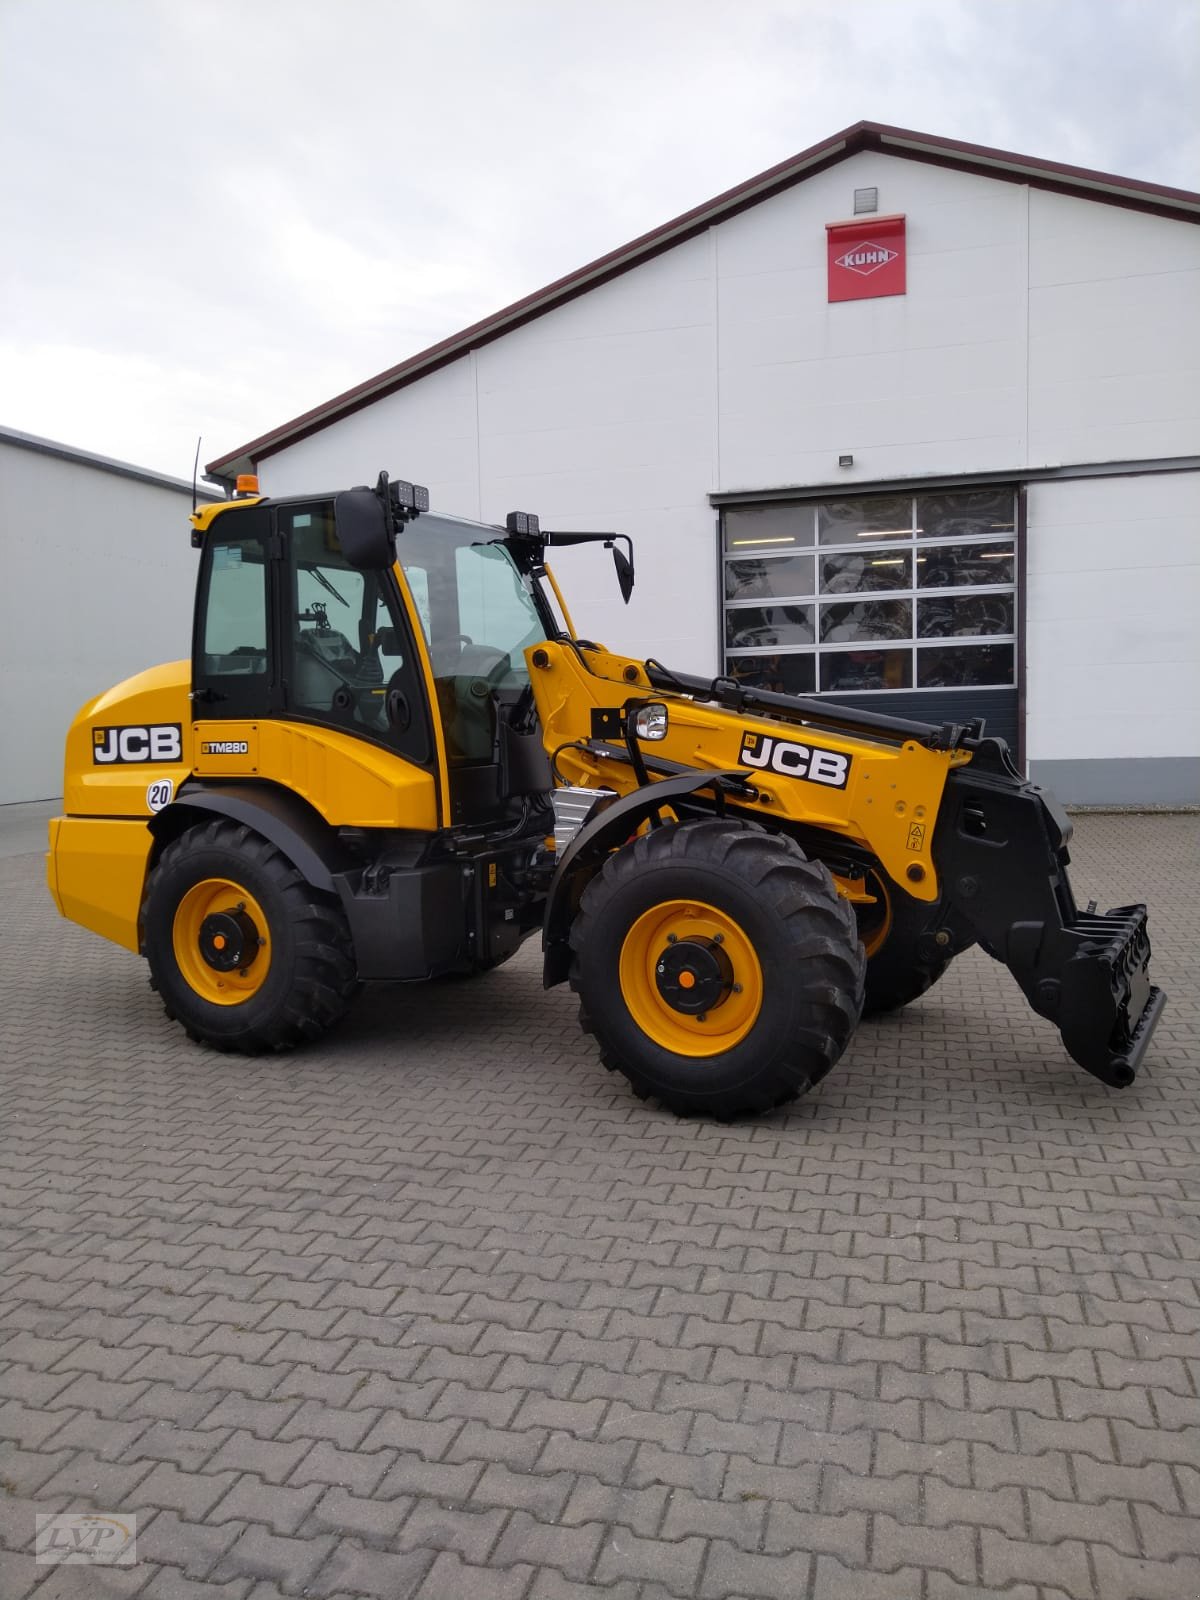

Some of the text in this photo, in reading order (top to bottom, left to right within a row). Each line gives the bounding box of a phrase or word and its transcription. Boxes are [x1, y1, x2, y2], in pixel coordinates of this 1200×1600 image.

[844, 250, 889, 266] KUHN
[95, 726, 181, 762] JCB
[209, 743, 248, 753] TM280
[741, 738, 848, 786] JCB
[151, 785, 169, 805] 20
